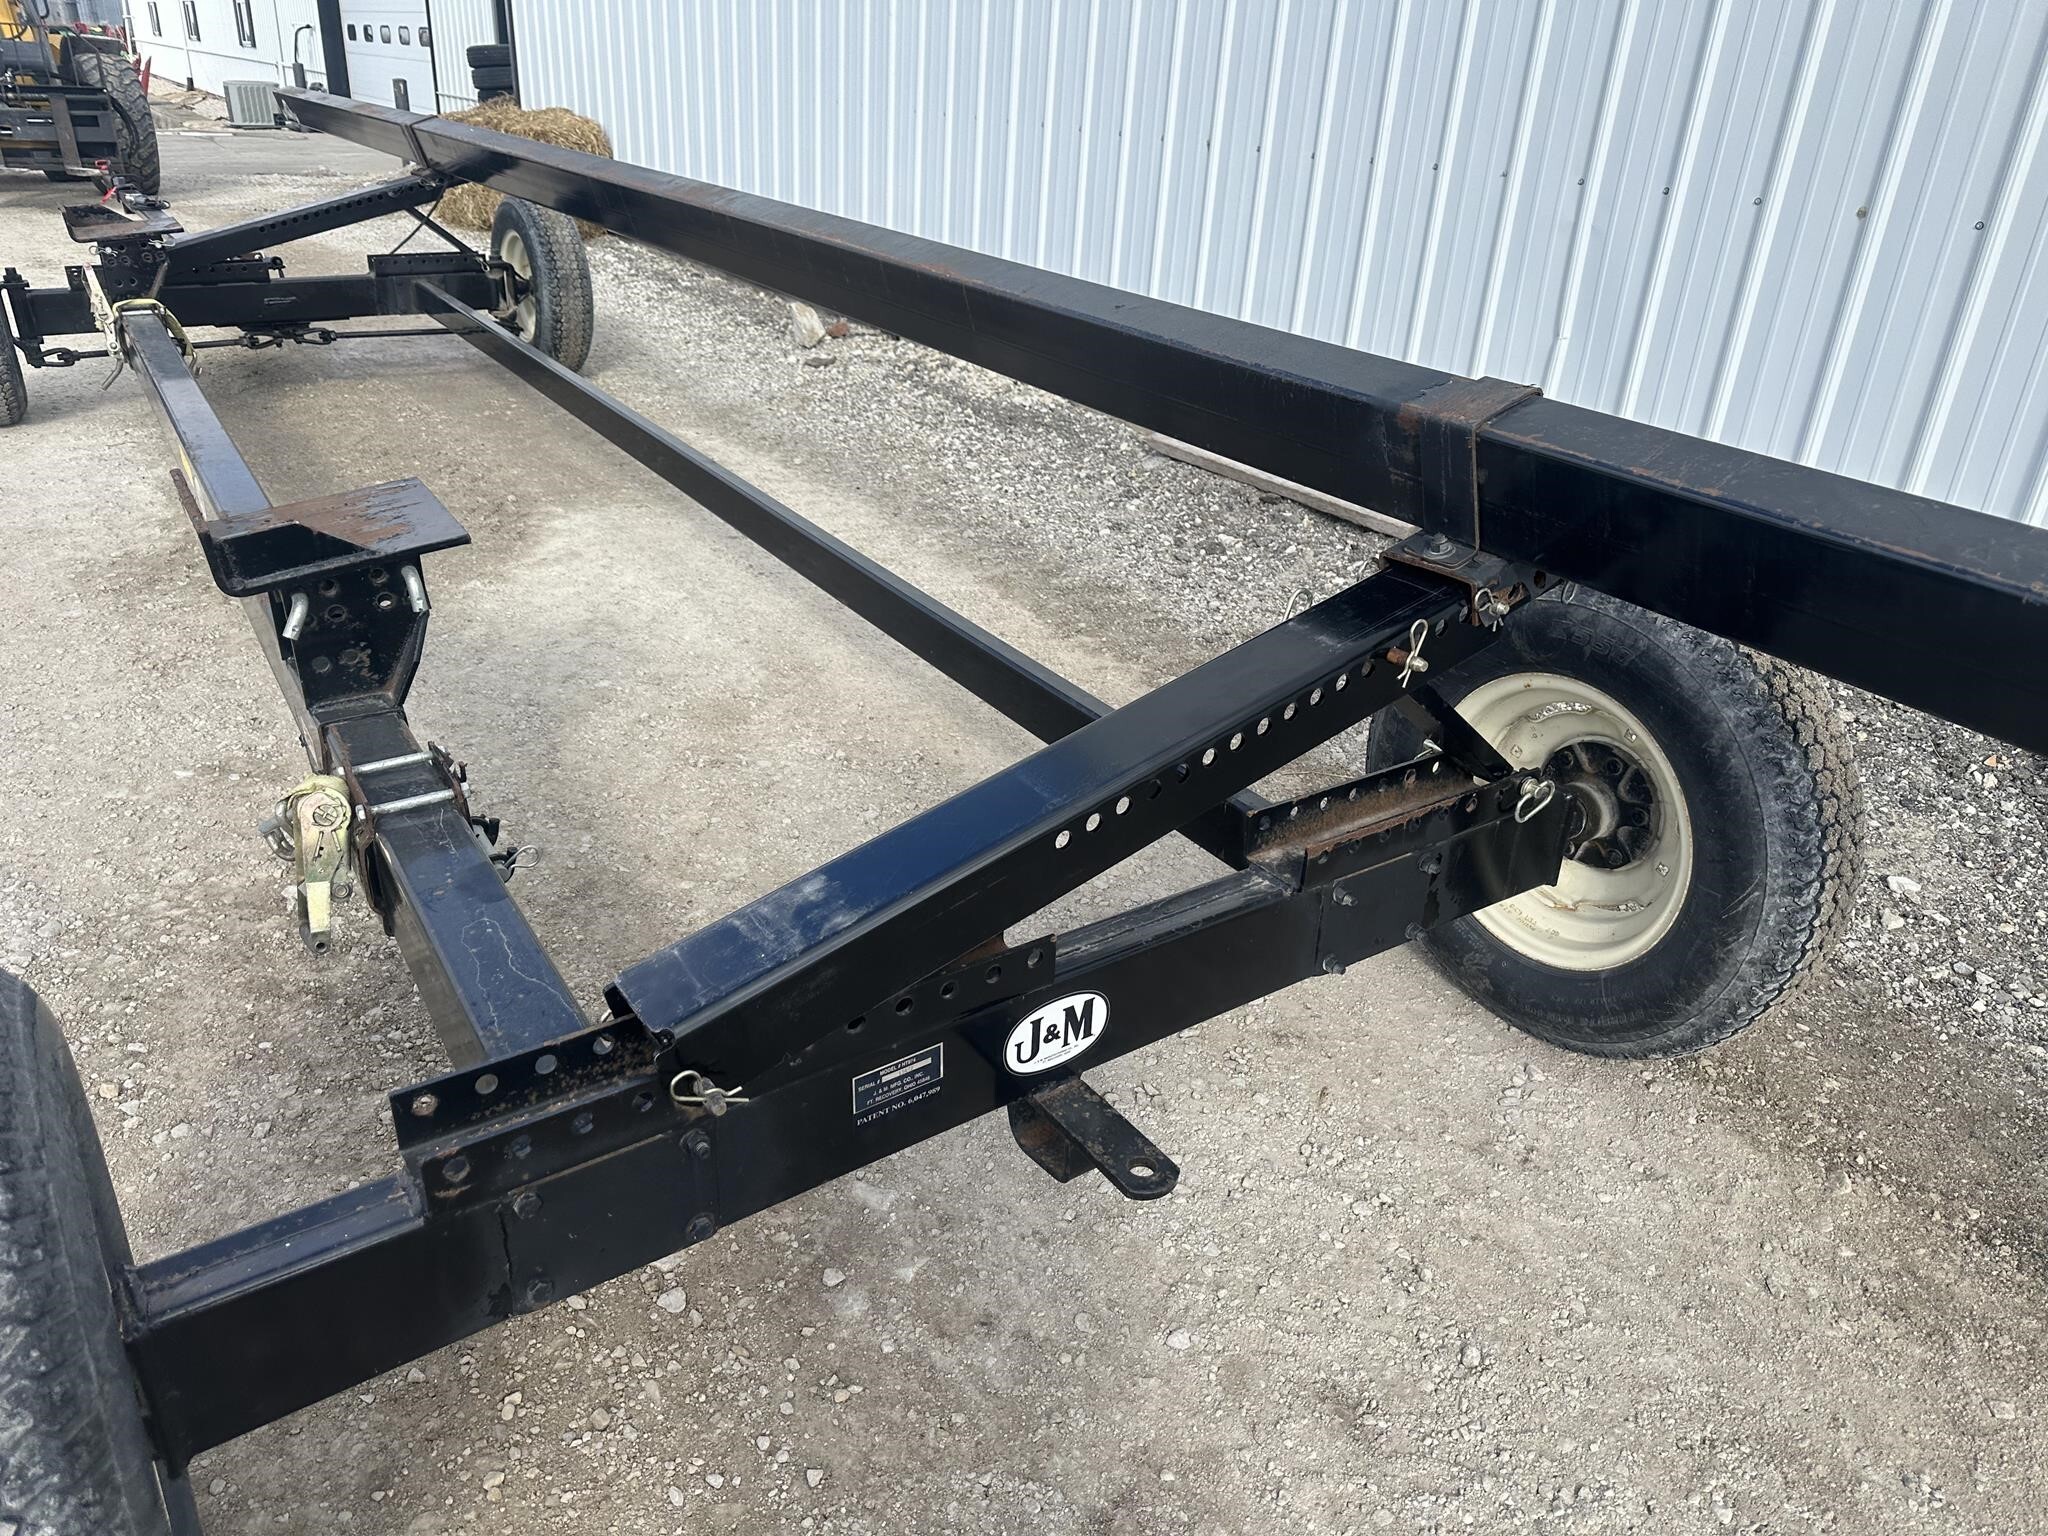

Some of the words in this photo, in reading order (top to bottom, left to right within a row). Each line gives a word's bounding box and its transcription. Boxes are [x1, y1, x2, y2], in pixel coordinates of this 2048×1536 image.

[1014, 997, 1096, 1064] J&M
[880, 1065, 897, 1076] MODEL
[858, 1082, 875, 1092] SERIAL
[903, 1081, 916, 1090] OHIO
[857, 1108, 890, 1126] PATENT
[891, 1099, 907, 1111] NO.
